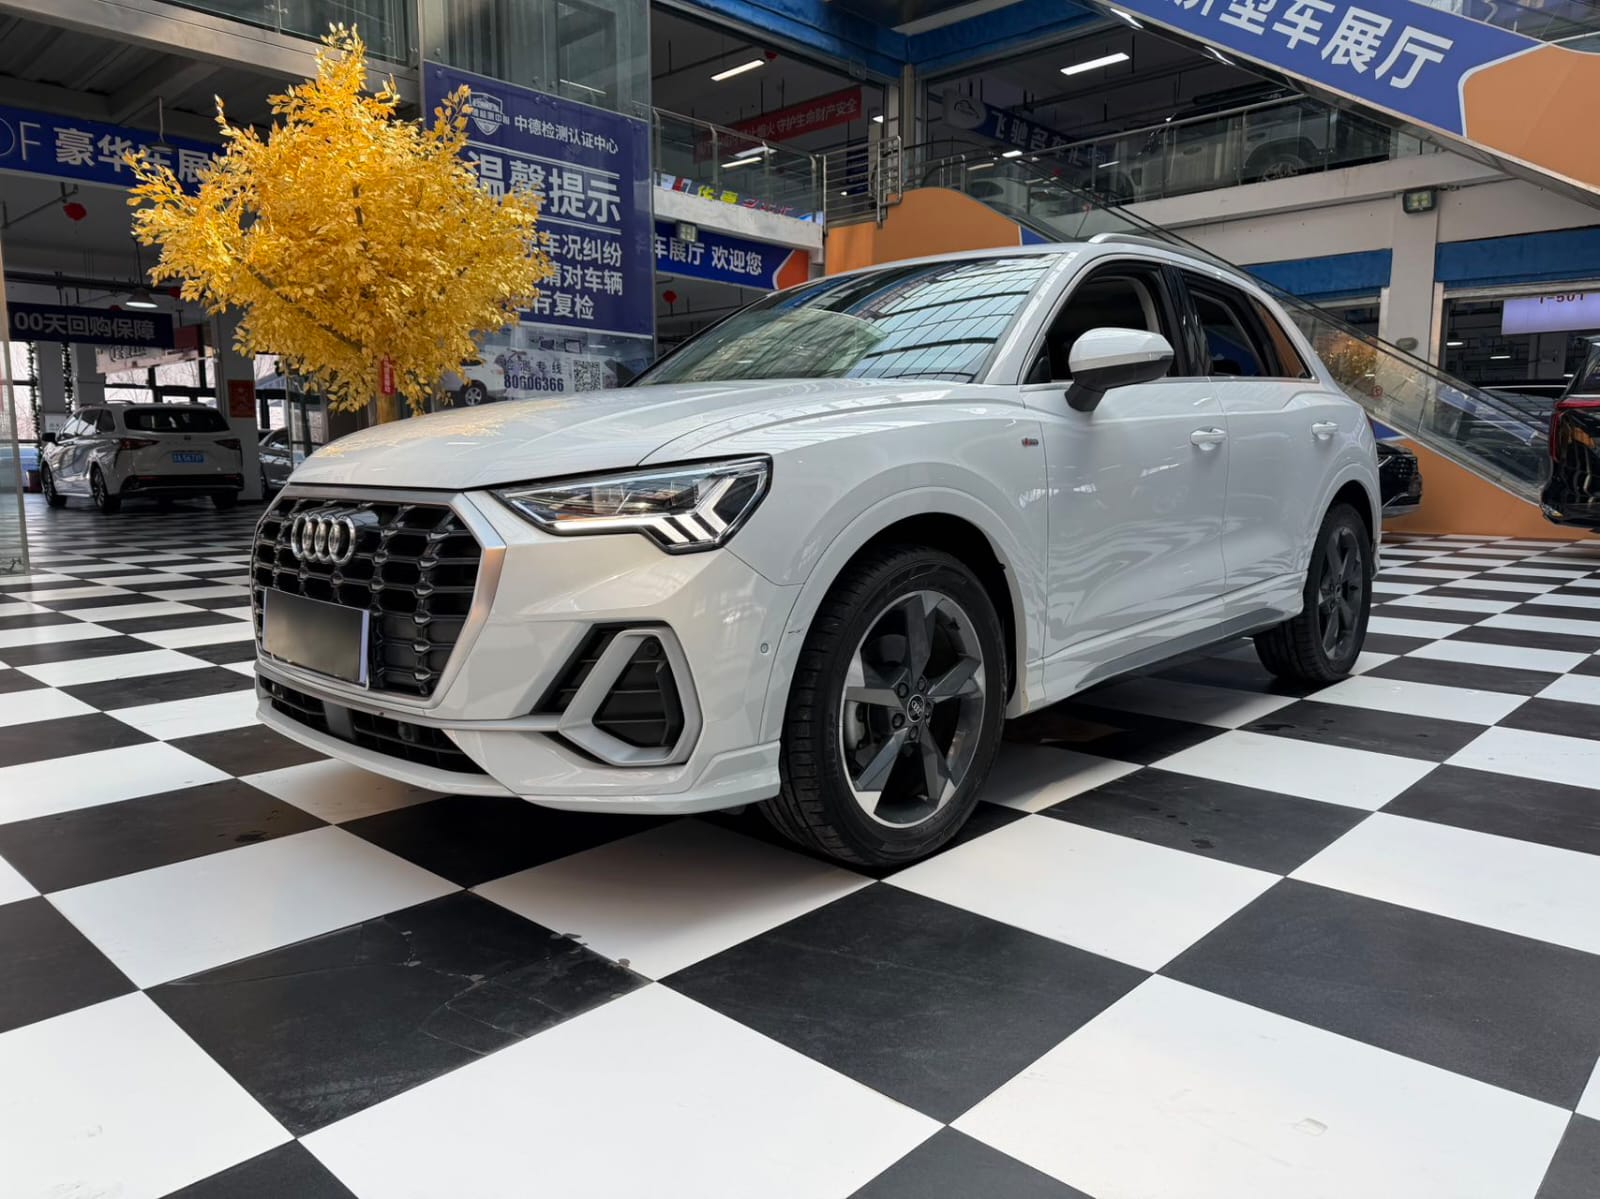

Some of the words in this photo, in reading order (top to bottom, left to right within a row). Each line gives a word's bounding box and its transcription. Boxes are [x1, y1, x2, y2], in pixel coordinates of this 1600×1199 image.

[1172, 0, 1454, 89] 型车展厅
[514, 114, 619, 155] 中德检测认证中心
[524, 231, 622, 268] 车况纠纷
[711, 245, 763, 276] 欢迎您
